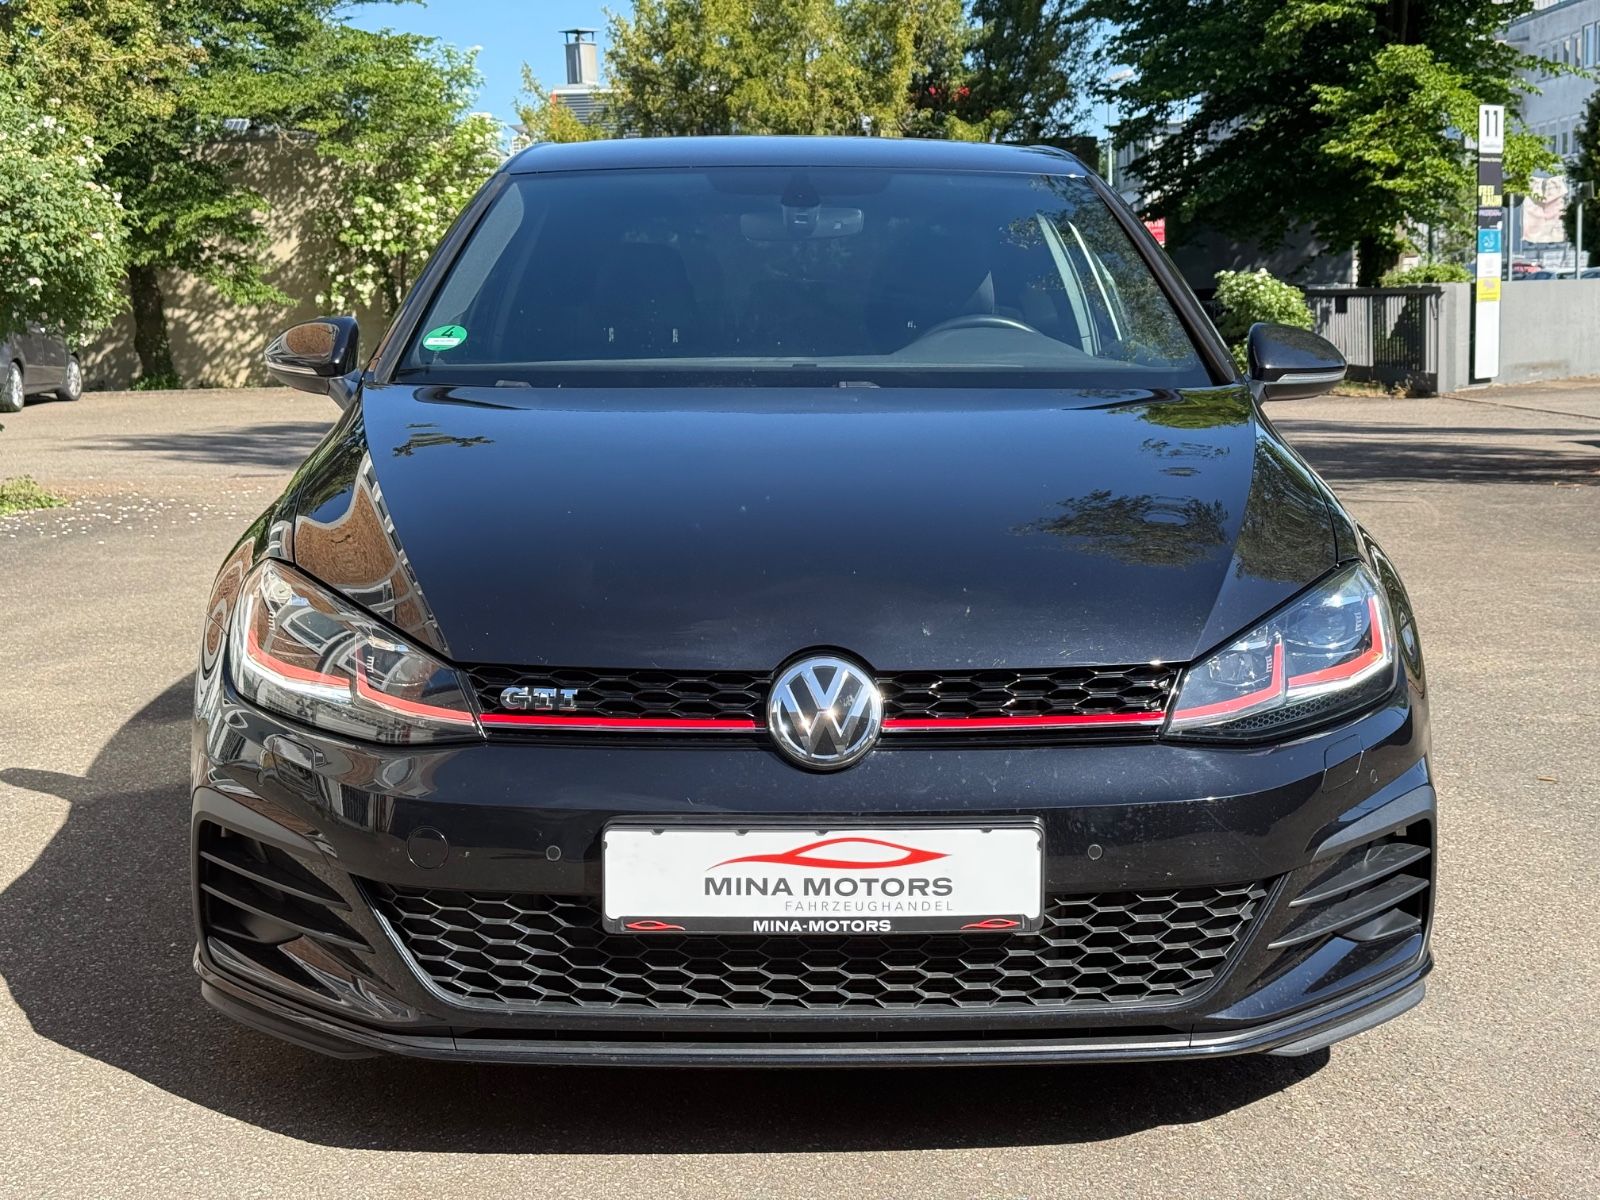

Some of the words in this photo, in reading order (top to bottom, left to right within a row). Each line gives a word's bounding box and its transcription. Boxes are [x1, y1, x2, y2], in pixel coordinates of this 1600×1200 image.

[1484, 109, 1498, 137] 11
[441, 326, 455, 337] 4
[500, 686, 578, 711] GTI
[704, 877, 794, 896] MINA
[803, 877, 953, 897] MOTORS
[785, 900, 953, 912] FAHRZEUGHANDEL
[753, 920, 892, 932] MINA-MOTORS
